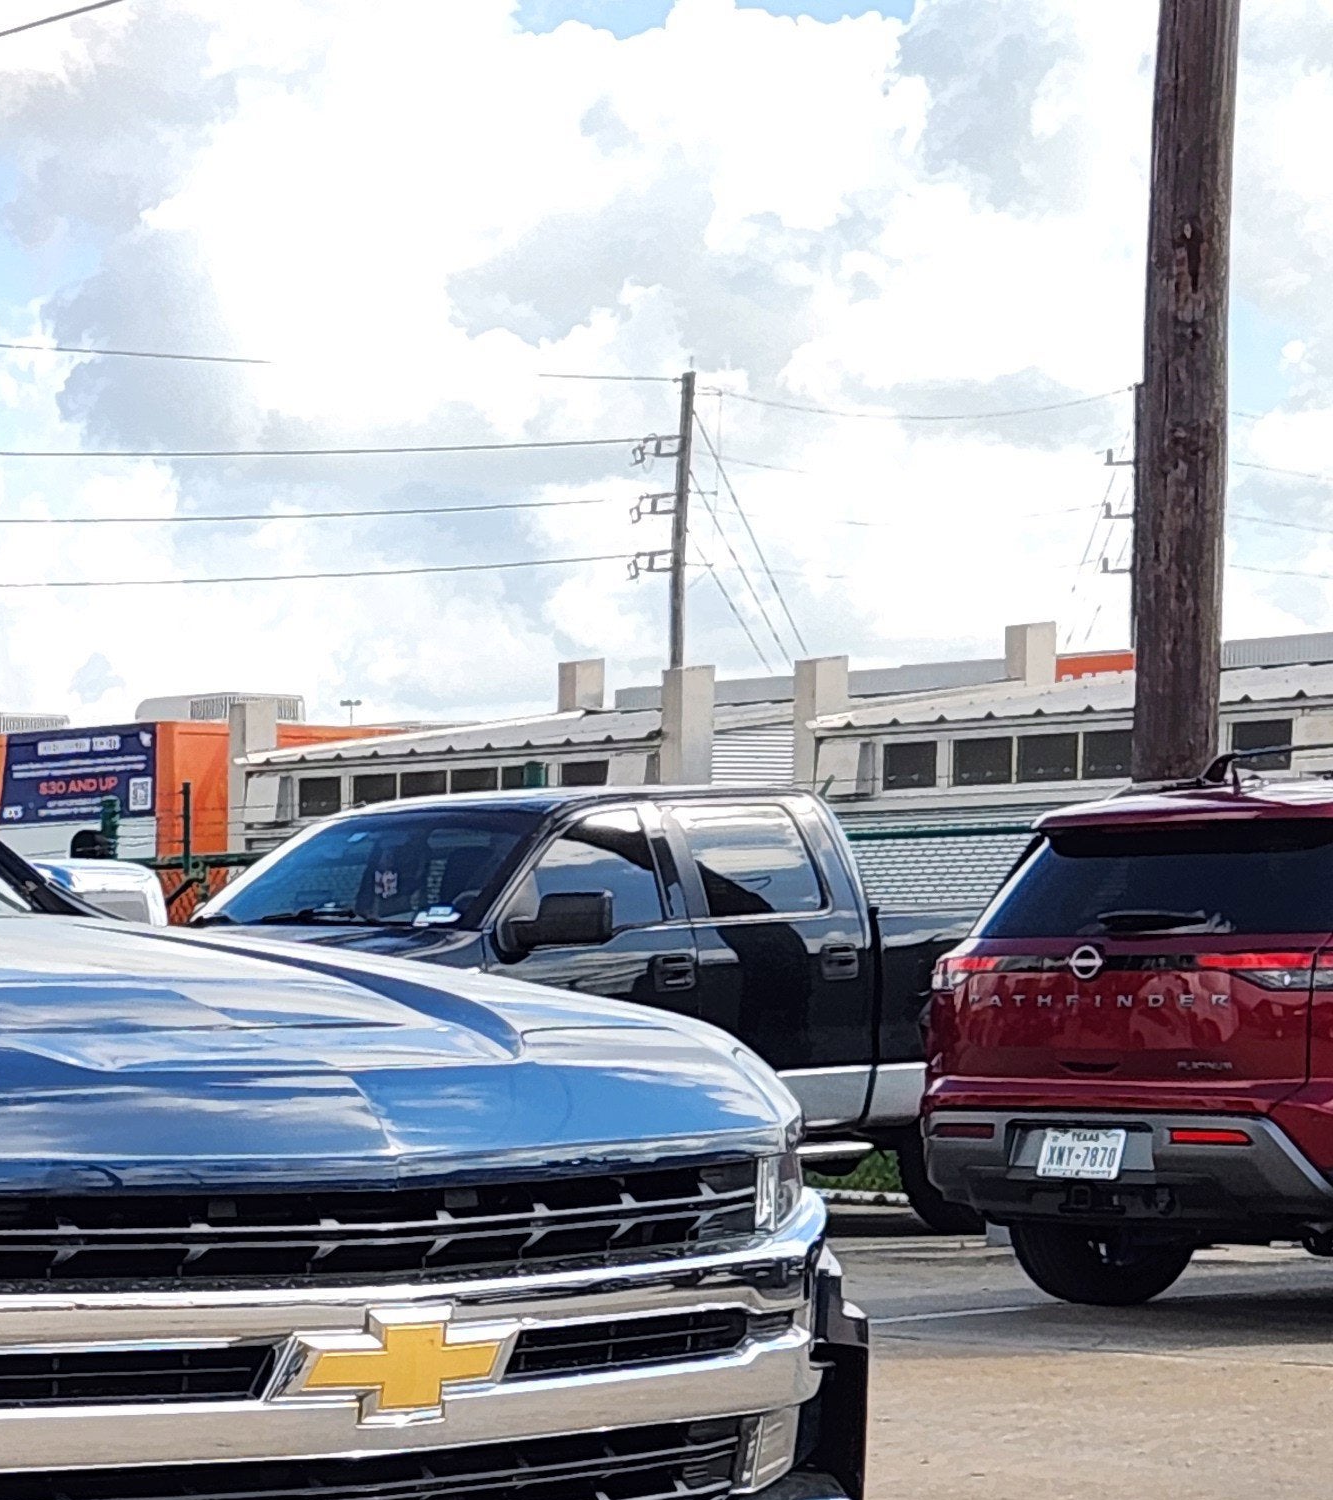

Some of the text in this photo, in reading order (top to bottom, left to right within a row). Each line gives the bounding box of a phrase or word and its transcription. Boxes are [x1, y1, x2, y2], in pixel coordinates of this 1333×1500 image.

[67, 779, 98, 793] AND
[98, 776, 119, 791] UP
[967, 994, 1230, 1007] PATHFINDER
